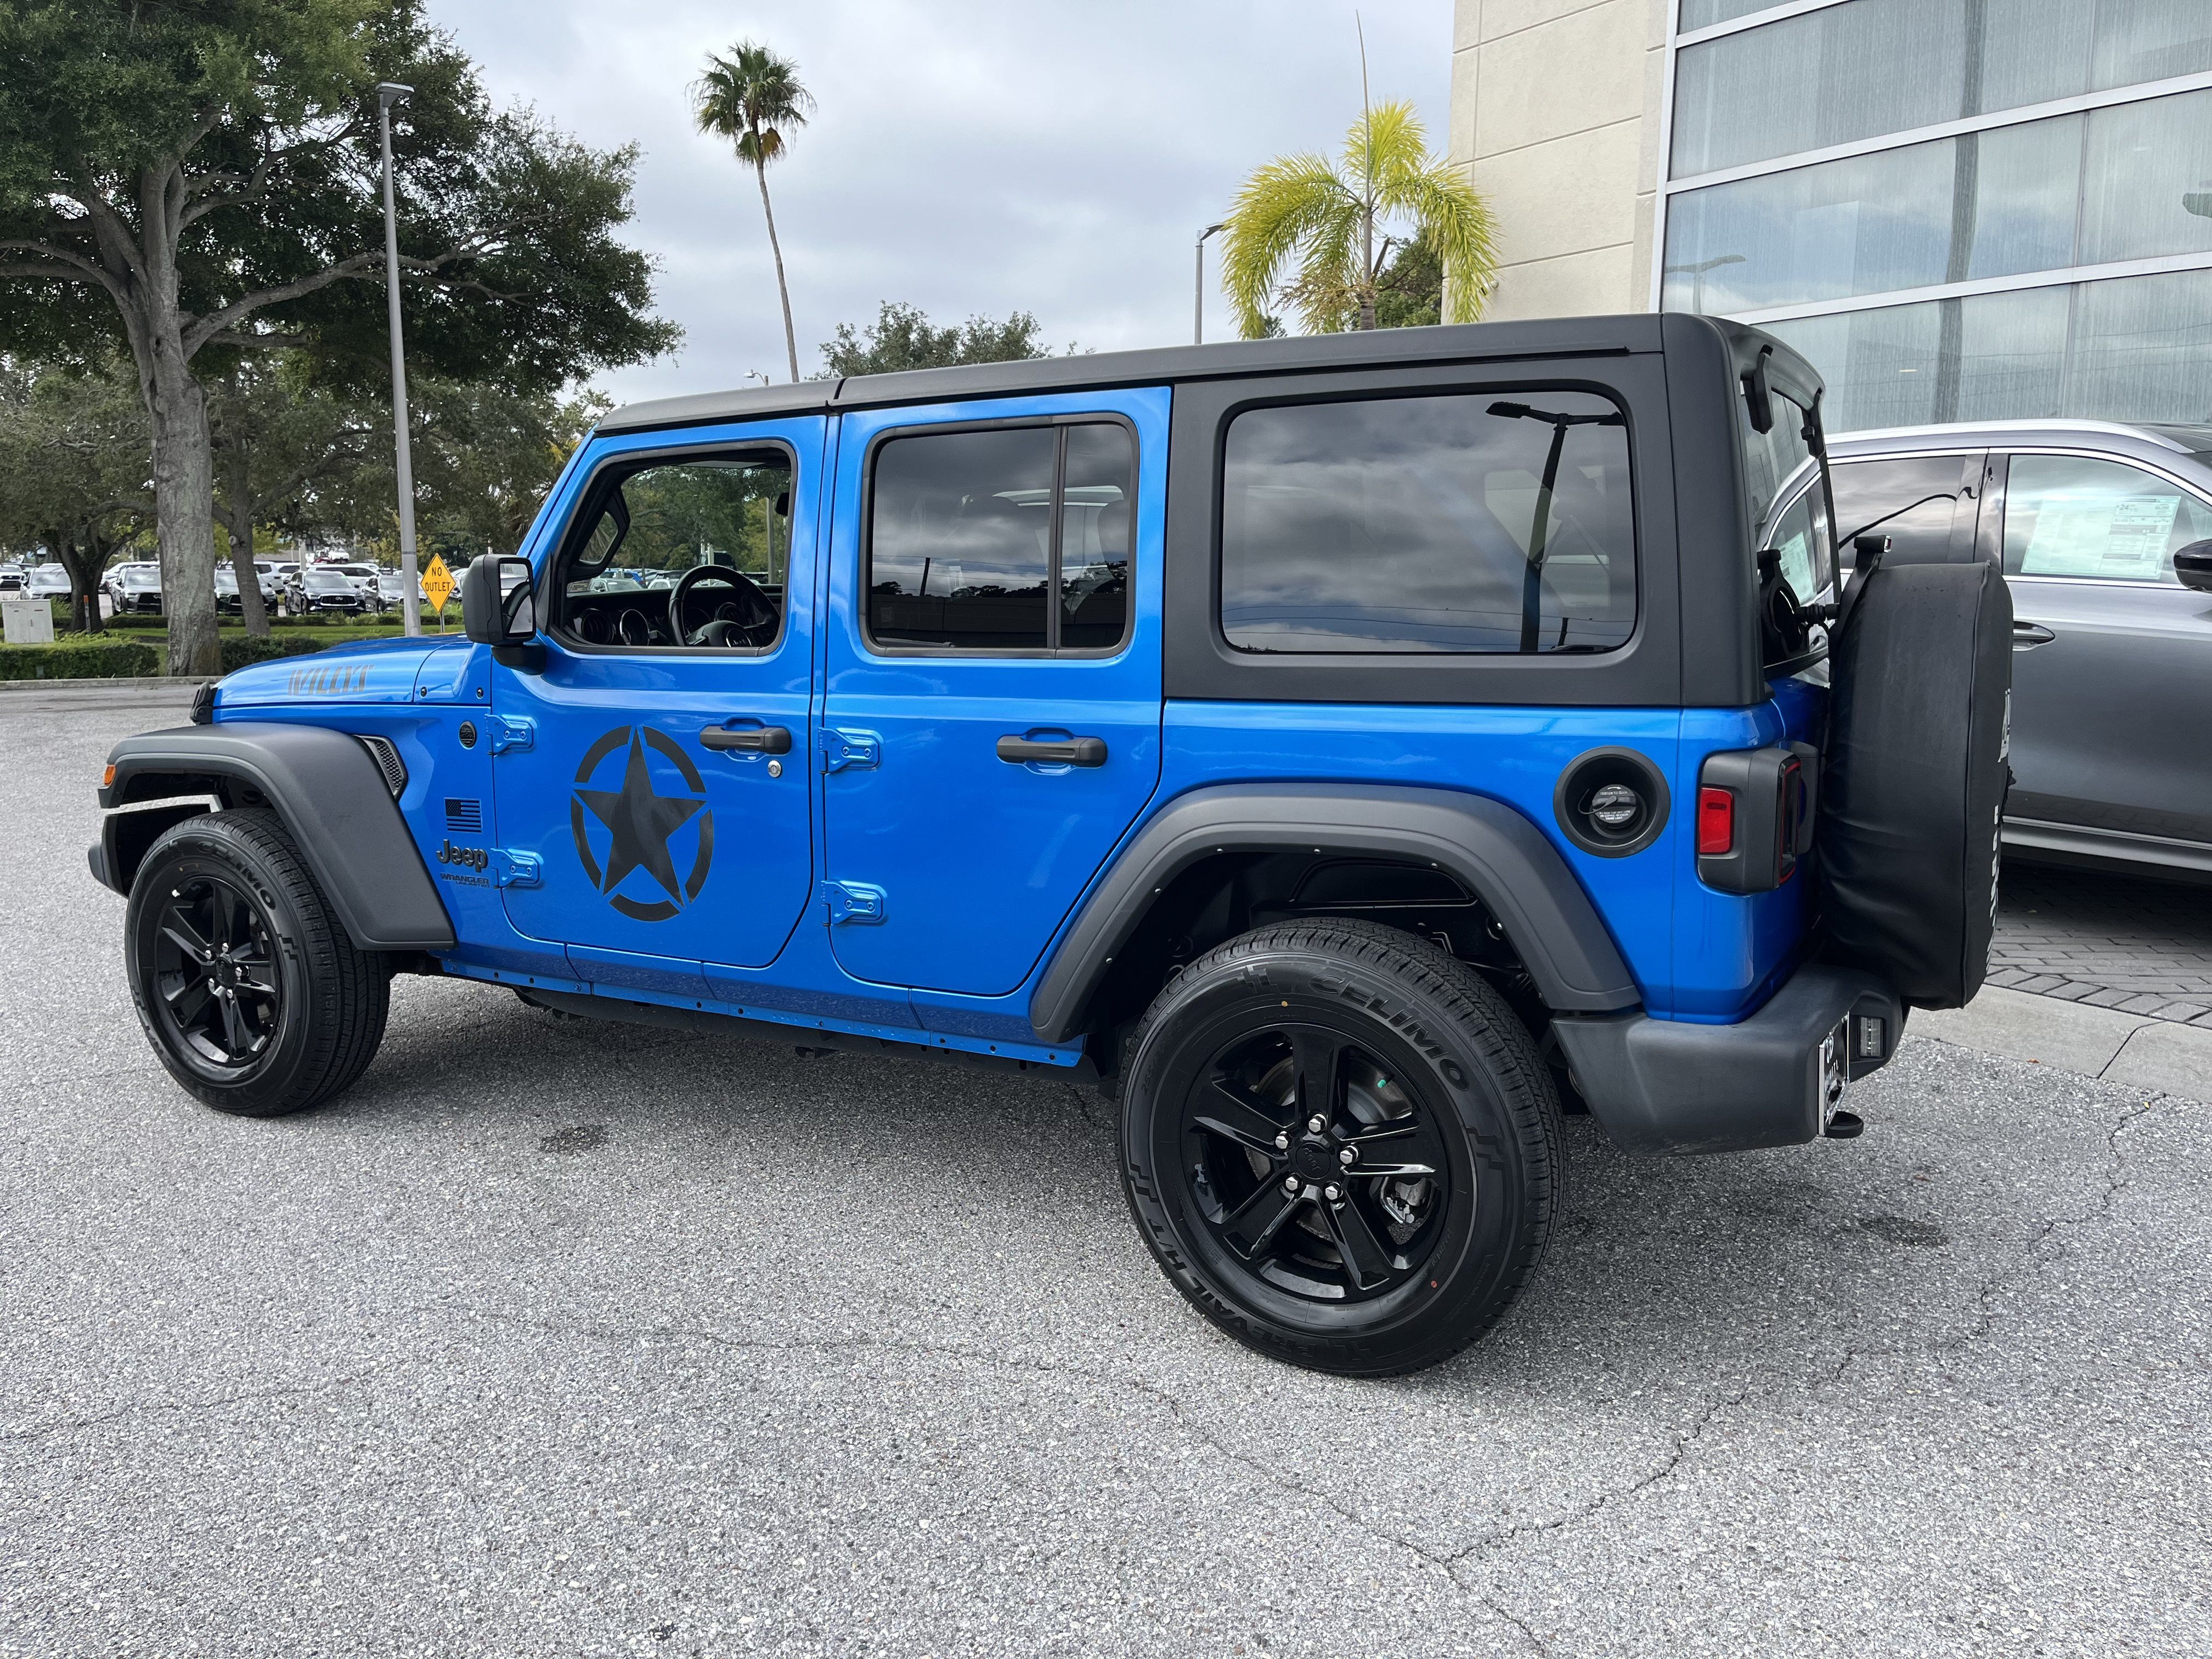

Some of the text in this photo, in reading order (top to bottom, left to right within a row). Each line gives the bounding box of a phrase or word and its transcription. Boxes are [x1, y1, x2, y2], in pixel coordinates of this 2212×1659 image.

[425, 582, 451, 591] OUTLET
[432, 567, 442, 576] NO
[288, 664, 374, 695] WILLYS
[436, 839, 488, 873] Jeep
[197, 840, 276, 910] CELIMO
[440, 873, 489, 885] WRANGLER
[1308, 974, 1470, 1091] CELIMO
[1189, 1276, 1317, 1358] PREVAIL
